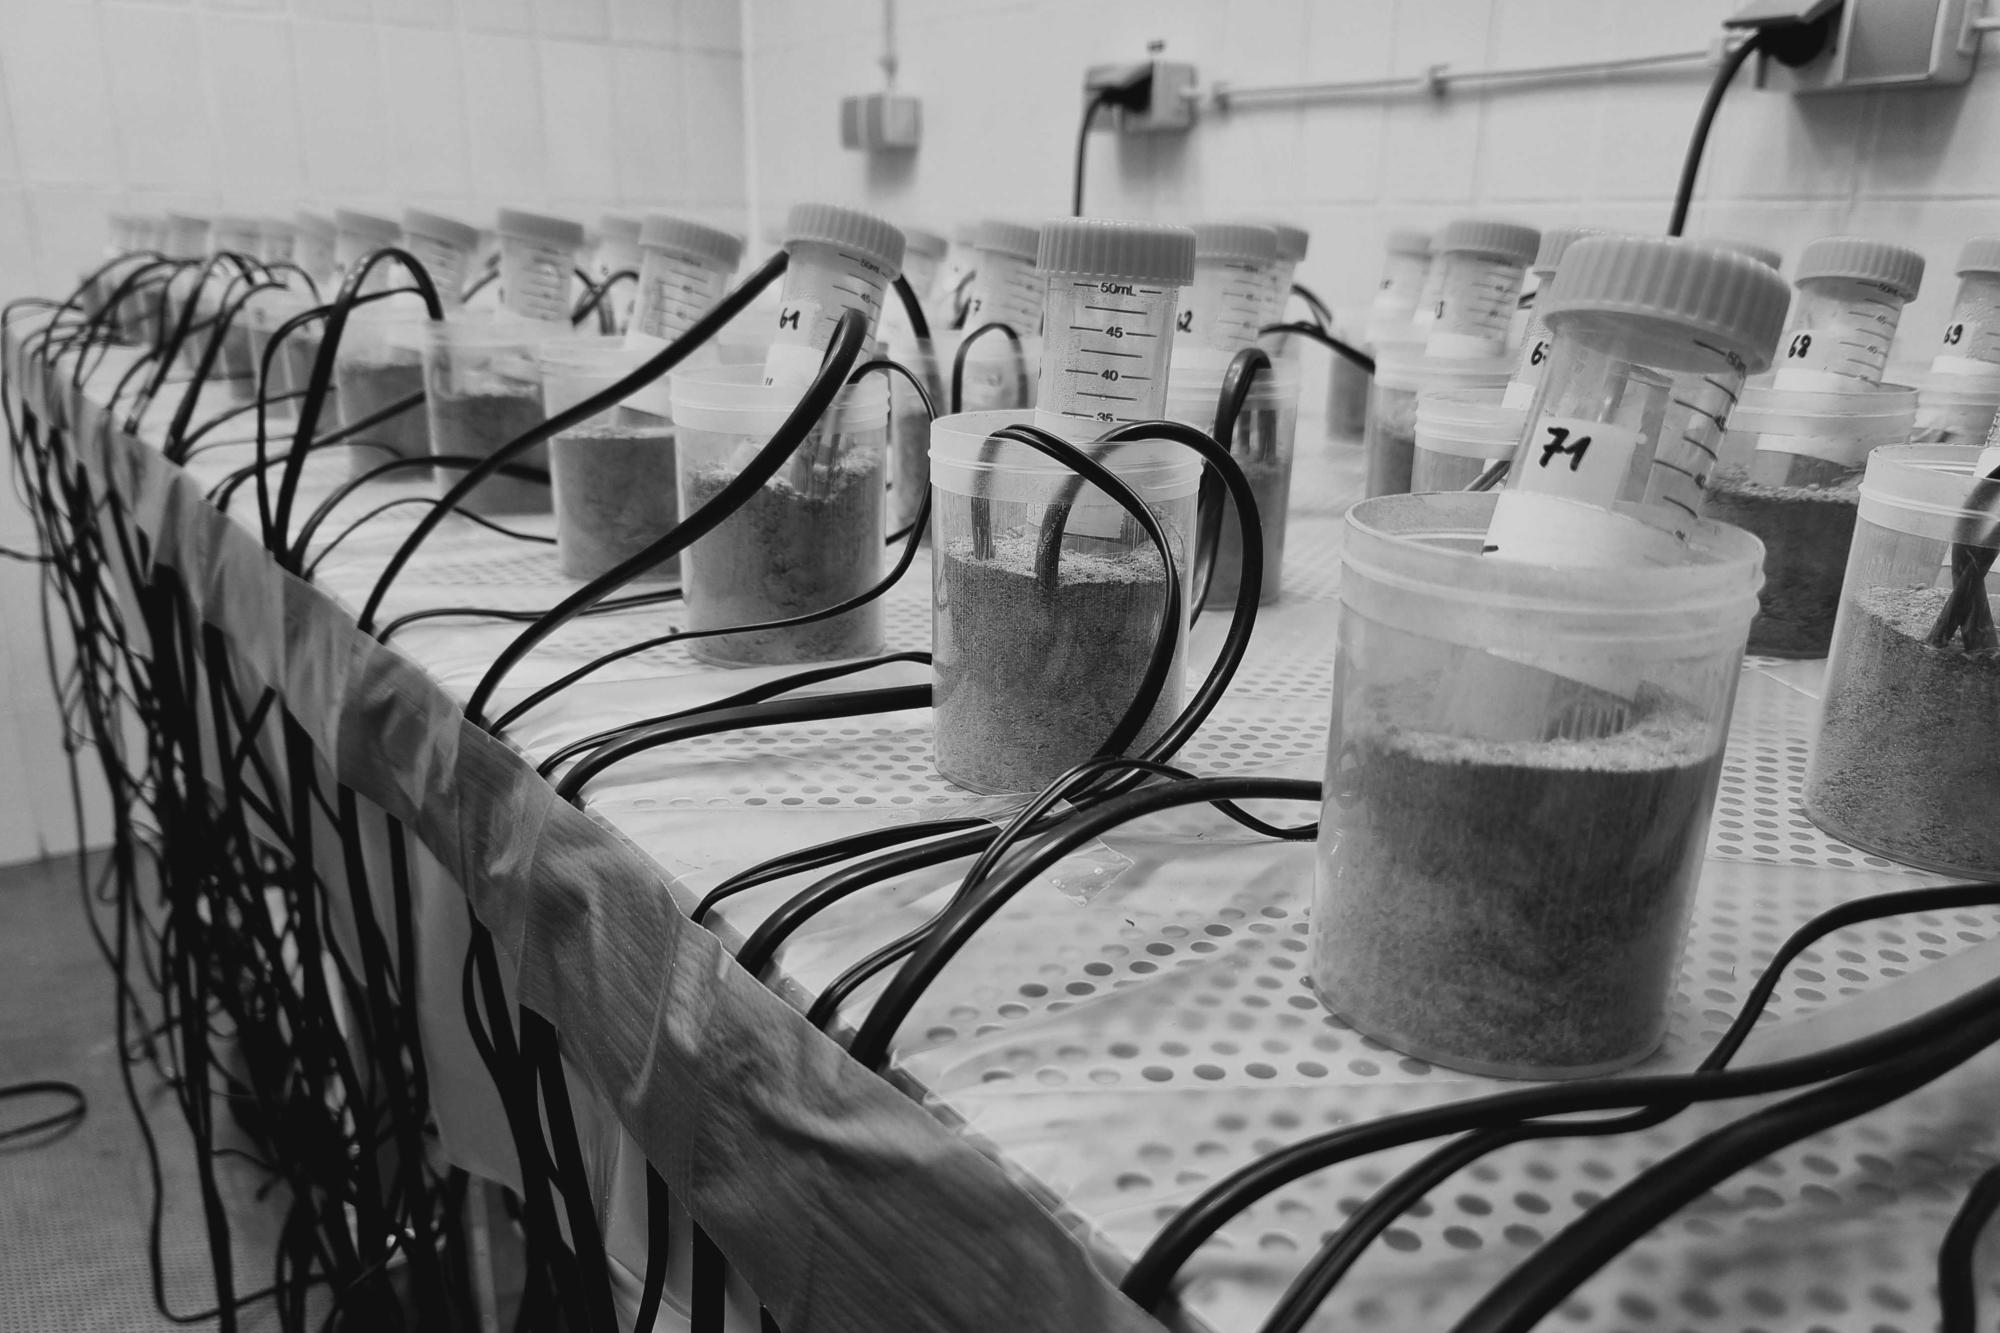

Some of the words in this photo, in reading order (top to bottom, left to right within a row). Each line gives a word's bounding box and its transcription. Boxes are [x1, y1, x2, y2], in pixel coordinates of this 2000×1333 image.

[1100, 282, 1137, 297] 50mL
[1106, 326, 1124, 339] 45
[1101, 369, 1119, 382] 40
[1096, 412, 1114, 423] 35
[1539, 427, 1592, 471] 71
